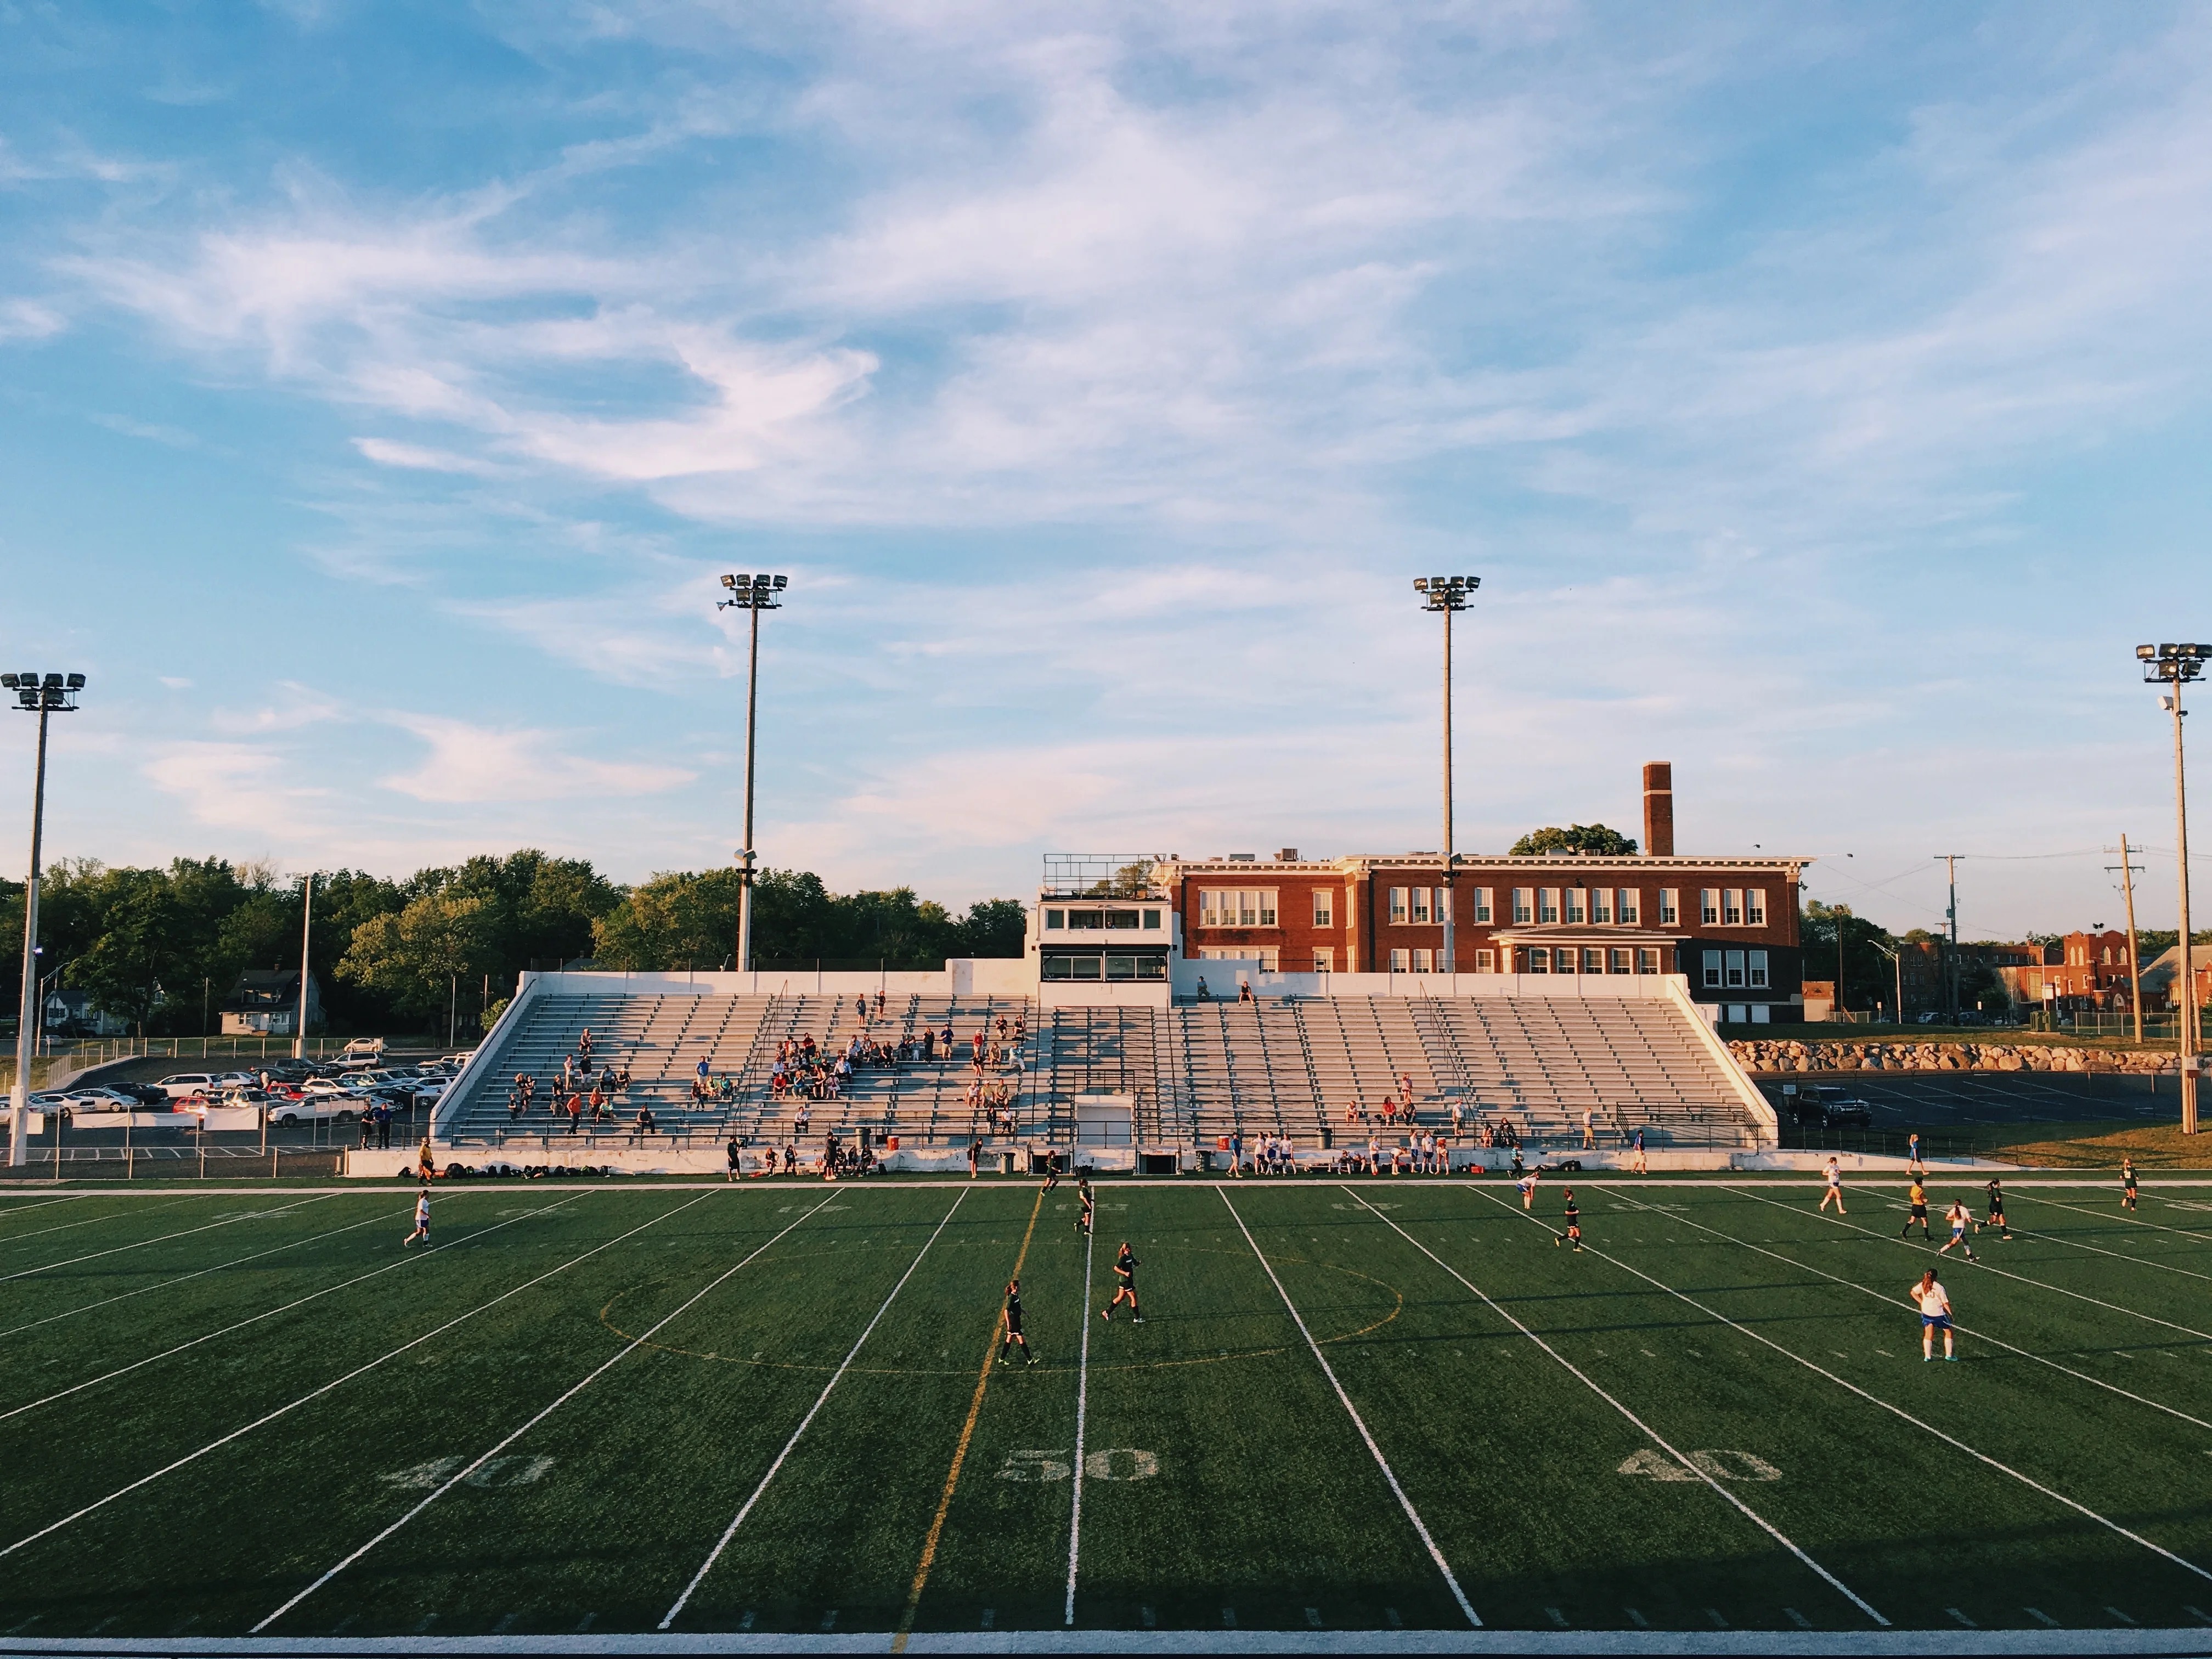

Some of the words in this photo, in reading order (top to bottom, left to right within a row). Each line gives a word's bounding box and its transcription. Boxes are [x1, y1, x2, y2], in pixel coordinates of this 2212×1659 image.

[381, 1455, 555, 1489] 40
[994, 1448, 1159, 1481] 50
[1617, 1449, 1782, 1482] 40
